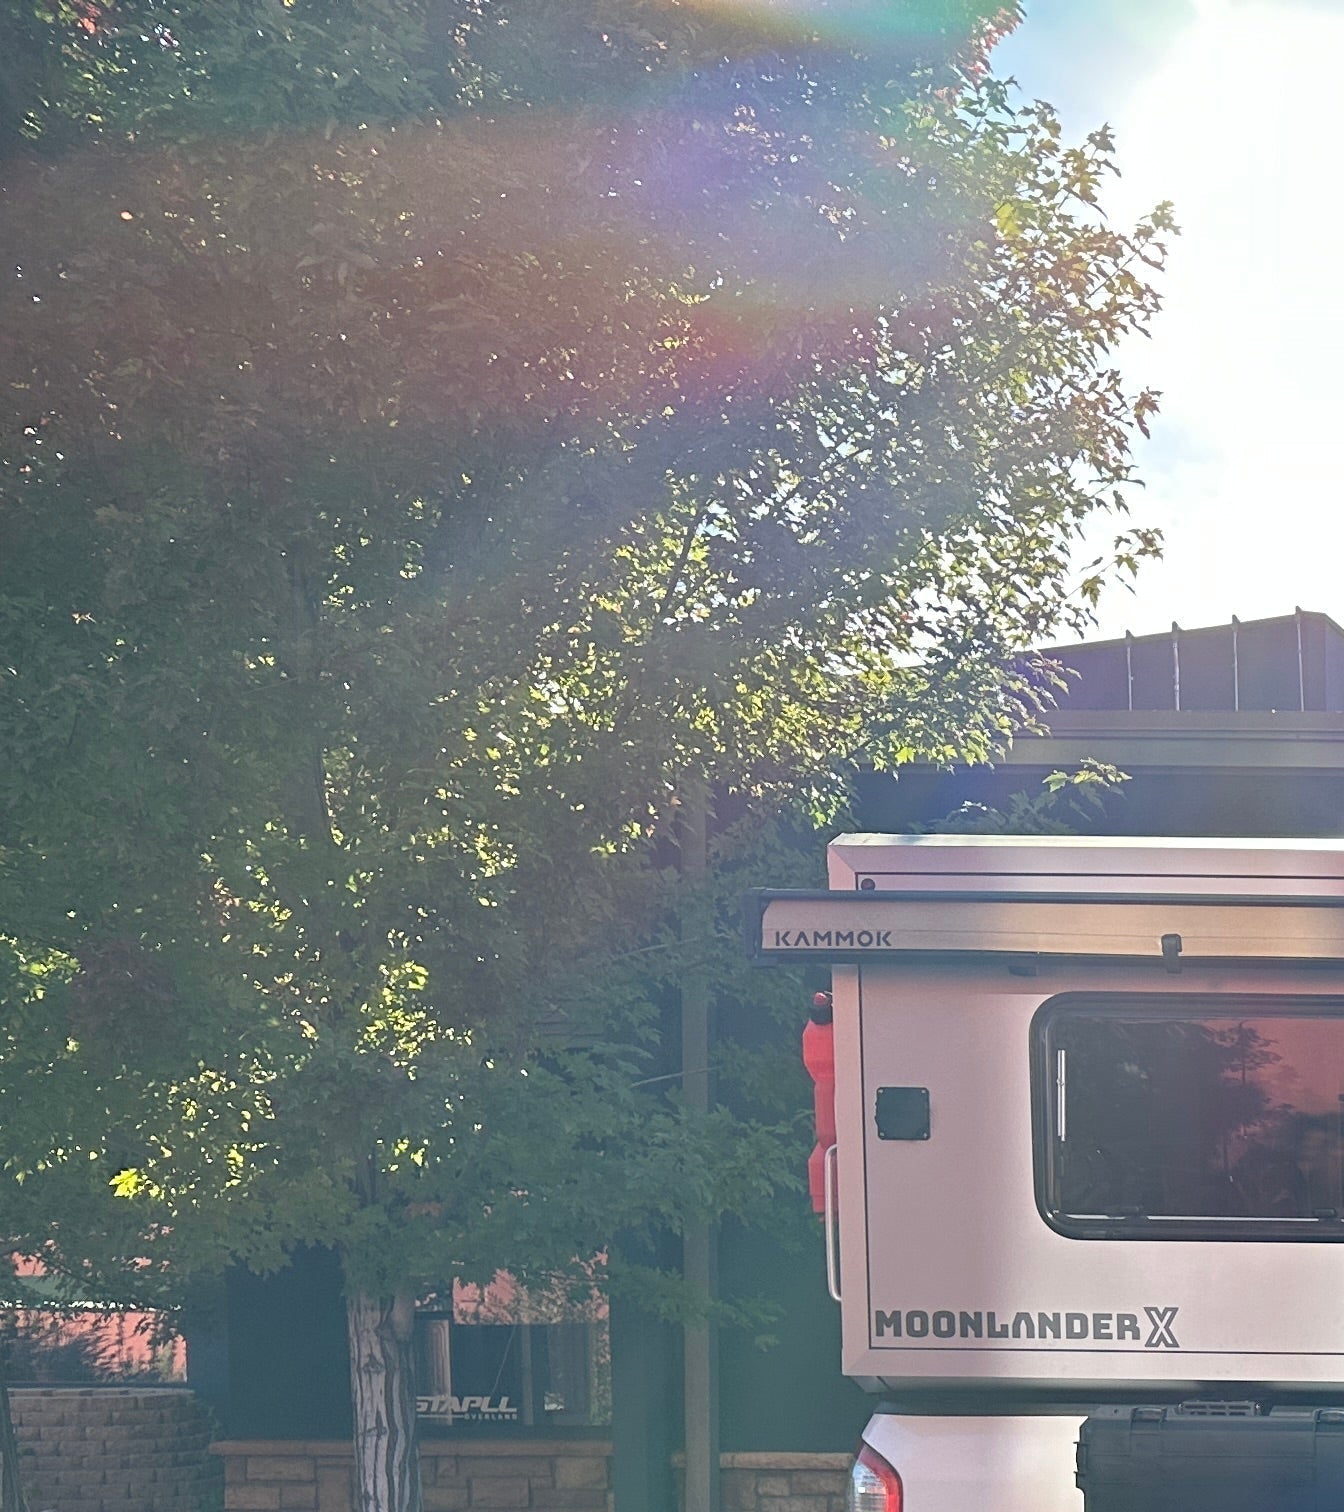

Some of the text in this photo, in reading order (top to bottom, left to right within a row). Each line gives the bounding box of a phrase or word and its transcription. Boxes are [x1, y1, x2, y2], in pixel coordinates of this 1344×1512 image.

[775, 930, 892, 947] KAMMOK
[874, 1306, 1180, 1347] MOONLANDER X
